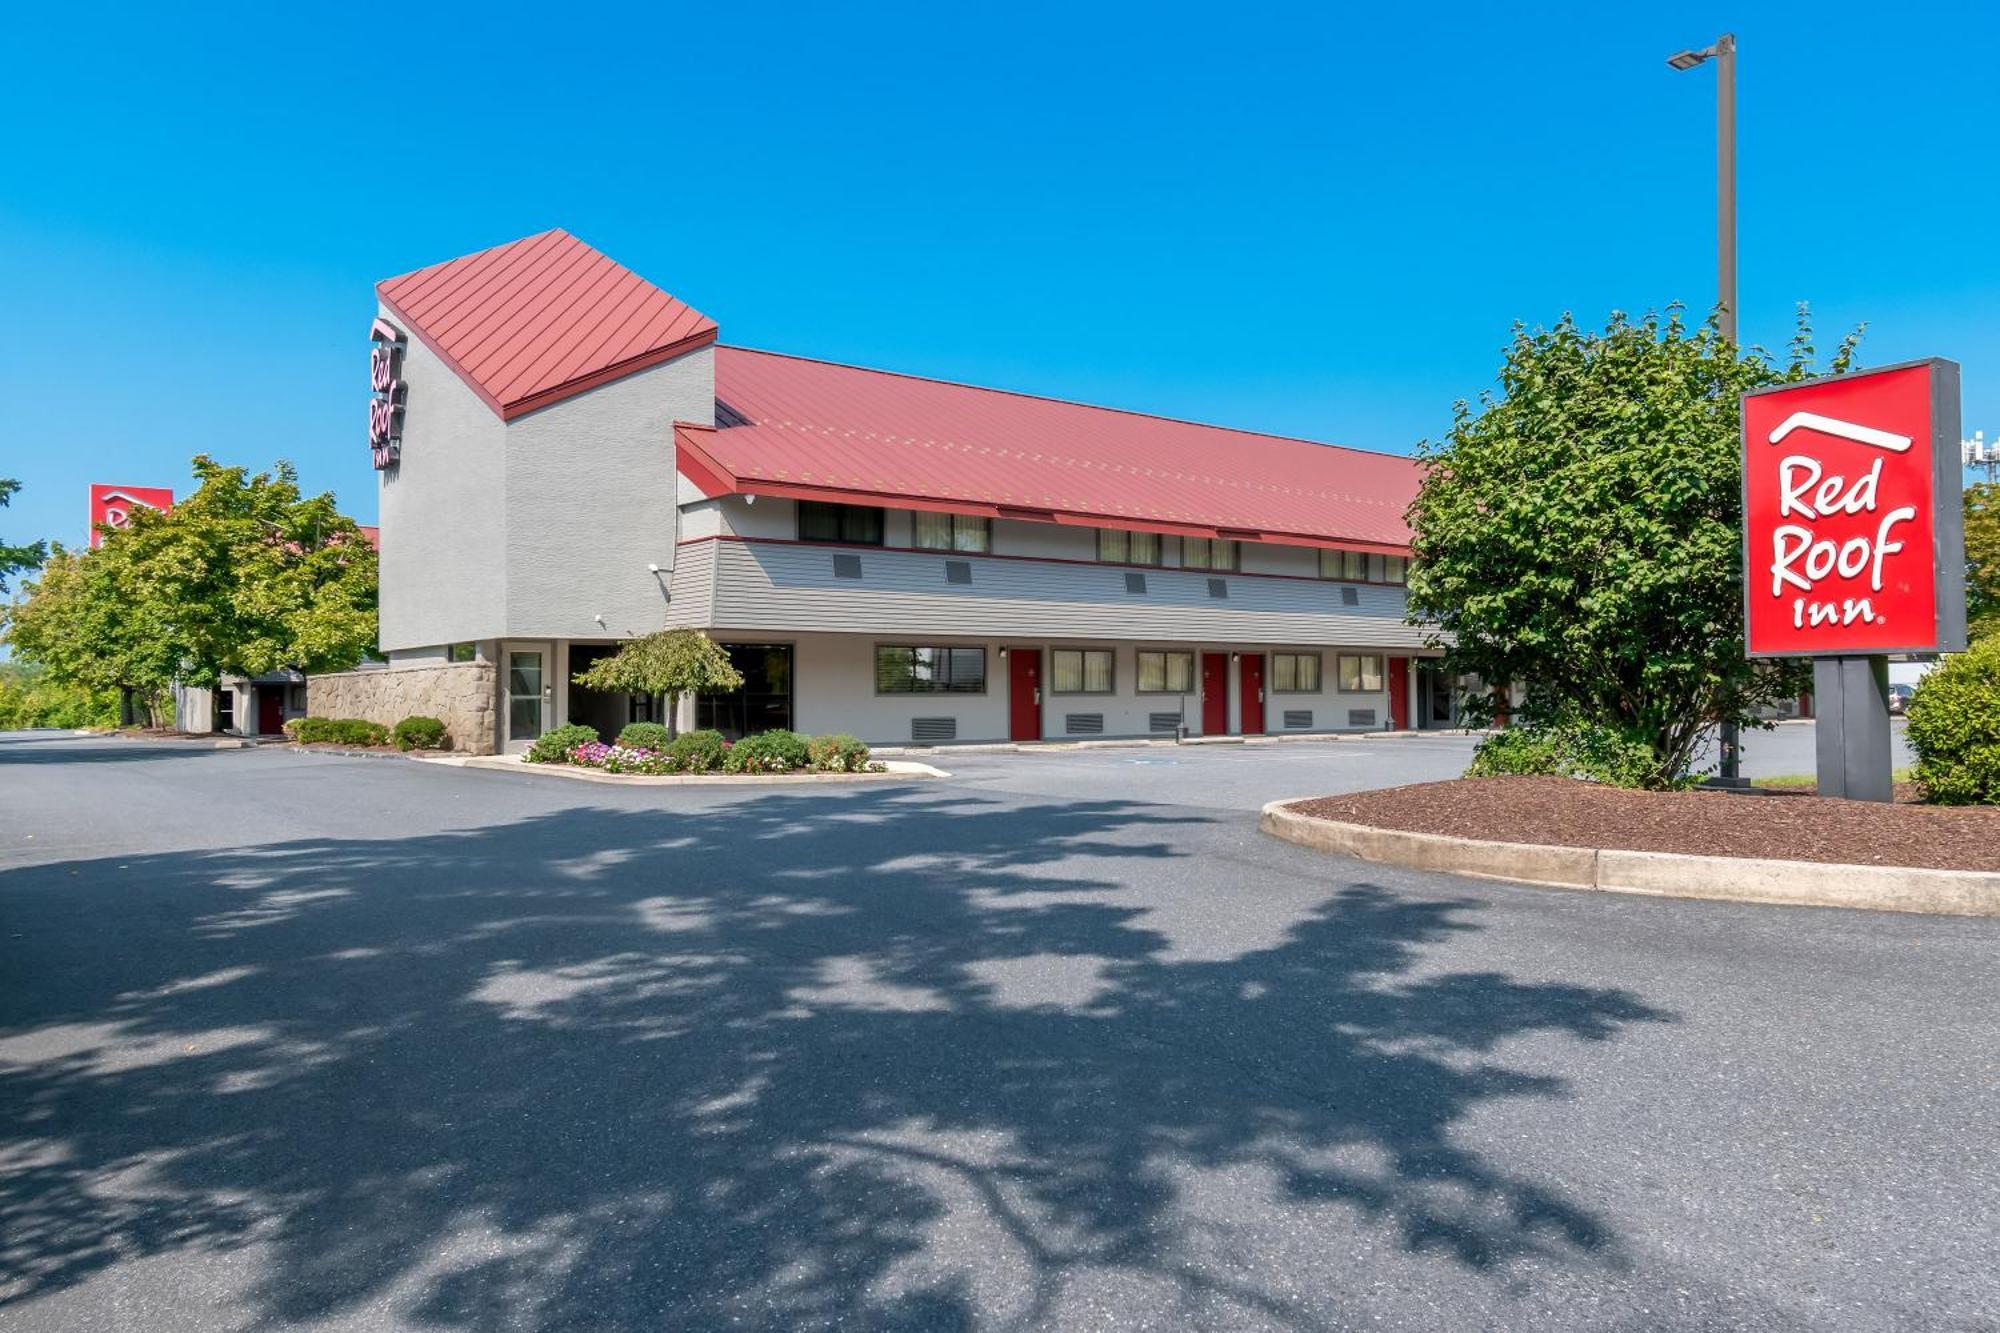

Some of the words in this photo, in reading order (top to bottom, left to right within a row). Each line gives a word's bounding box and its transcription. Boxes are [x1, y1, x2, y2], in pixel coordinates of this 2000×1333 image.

[371, 347, 391, 391] Red
[370, 380, 397, 444] Roof
[1779, 455, 1884, 519] Red
[1771, 506, 1916, 597] Roof
